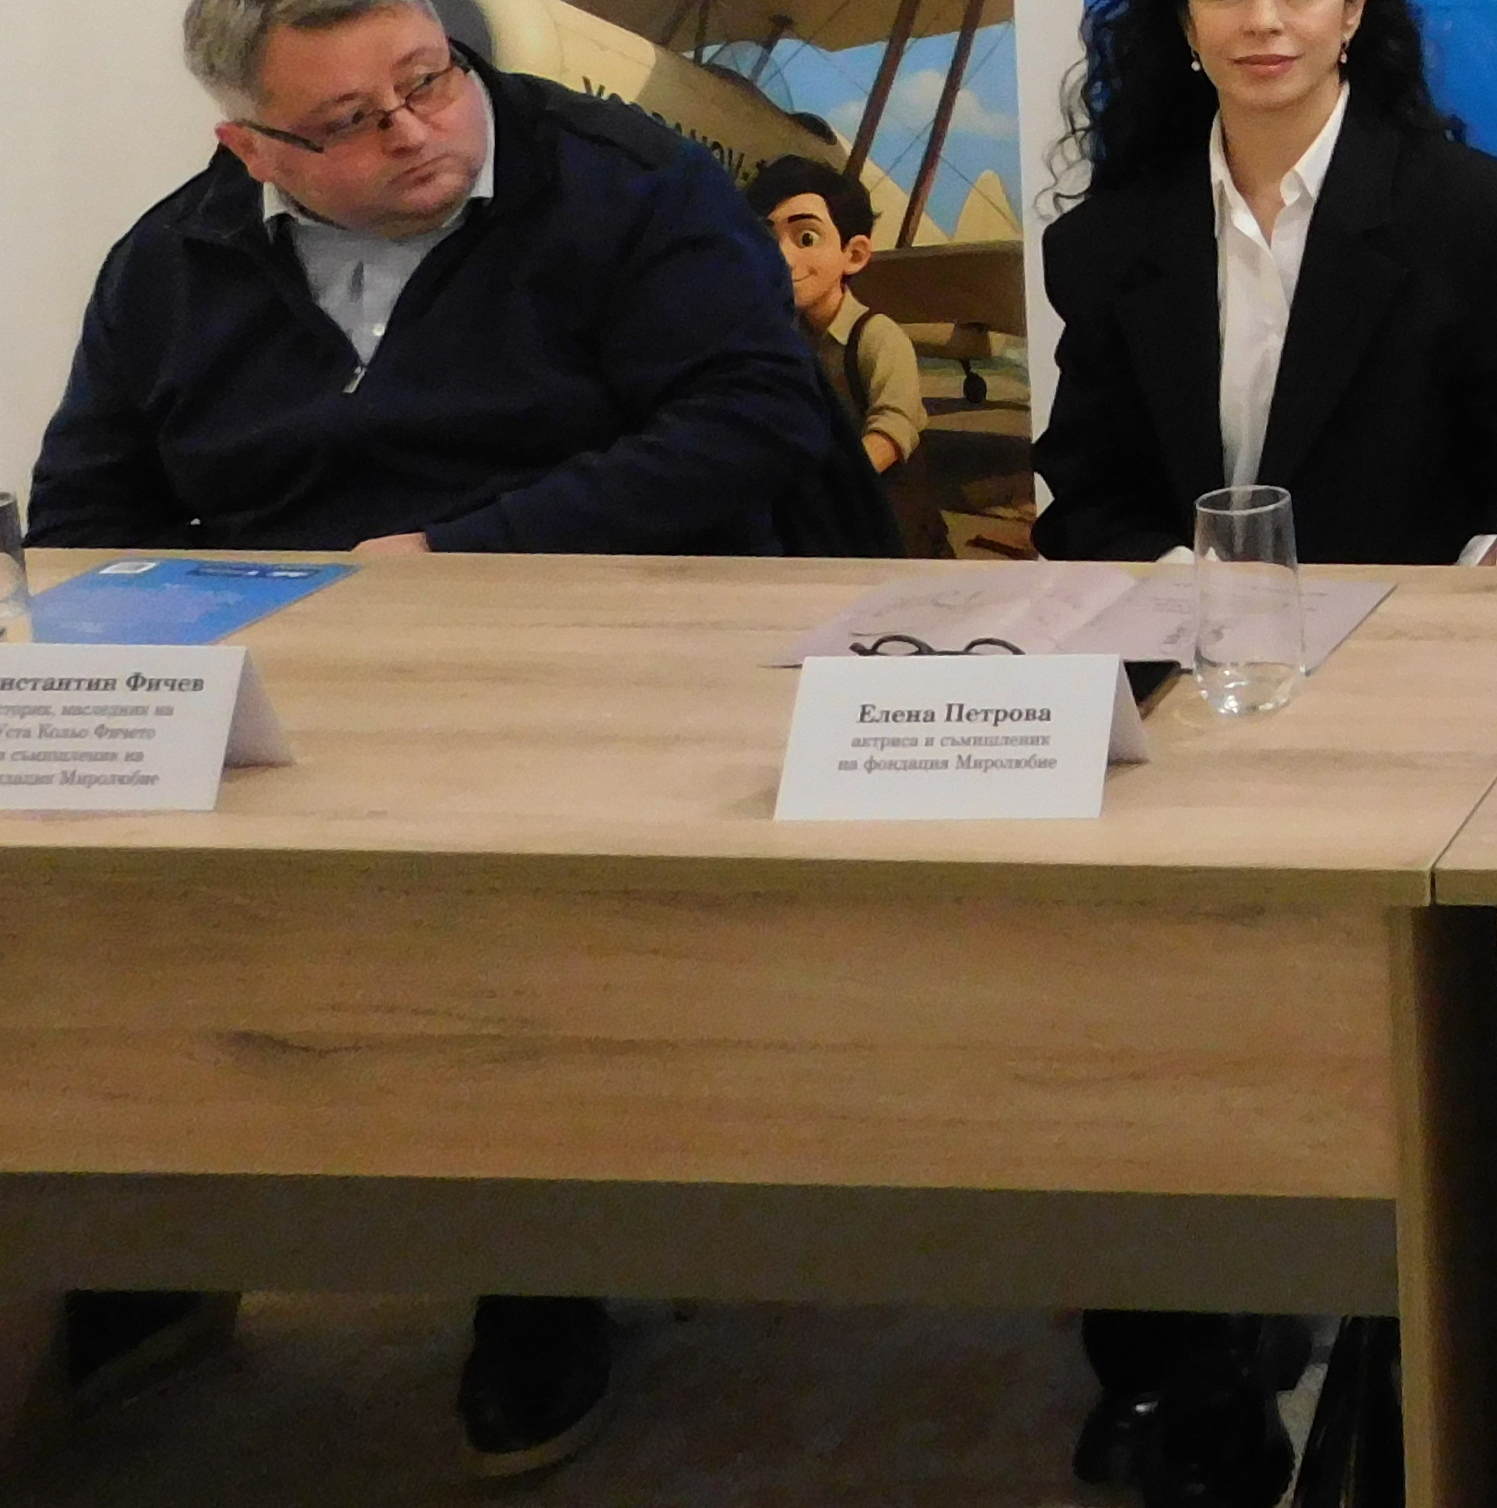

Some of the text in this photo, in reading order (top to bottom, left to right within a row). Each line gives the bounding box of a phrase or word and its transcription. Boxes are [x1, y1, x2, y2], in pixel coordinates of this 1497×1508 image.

[0, 672, 205, 691] нстантин Фичев
[857, 703, 1052, 727] Елена Петрова
[850, 736, 919, 751] актриса
[838, 754, 1058, 774] на фондация Миролюбие
